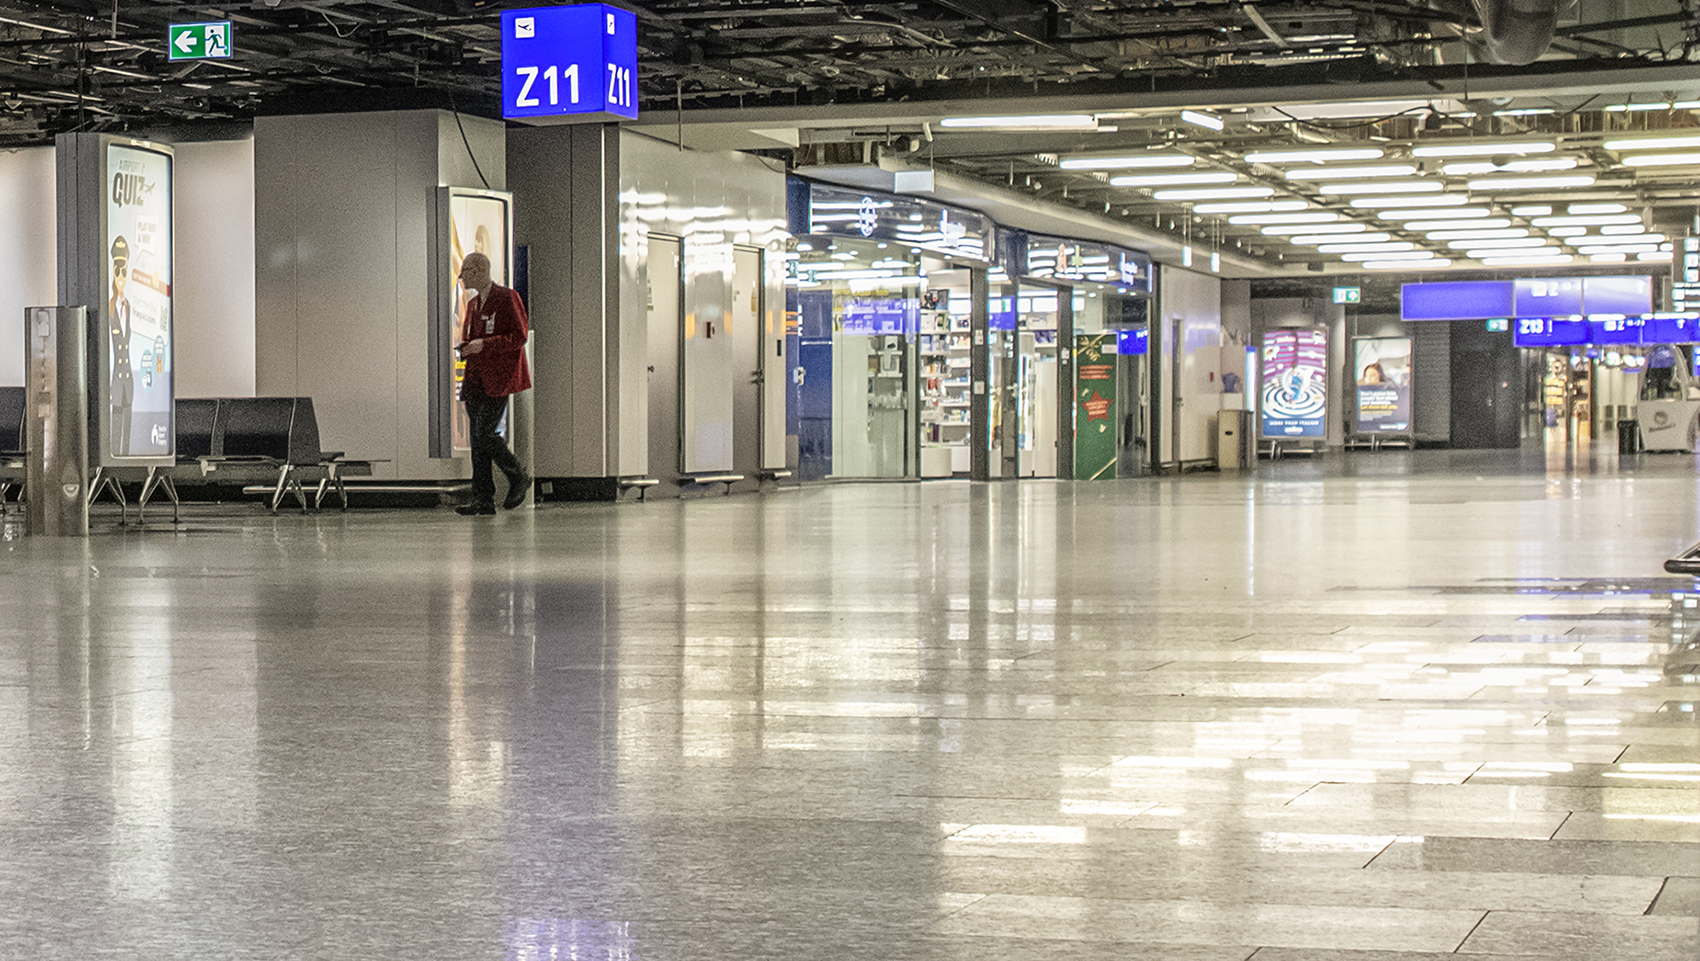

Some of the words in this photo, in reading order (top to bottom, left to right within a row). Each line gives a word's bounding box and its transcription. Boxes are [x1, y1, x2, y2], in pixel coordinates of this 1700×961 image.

[516, 64, 579, 107] Z11
[608, 63, 631, 107] Z11
[112, 172, 146, 208] QUIZ
